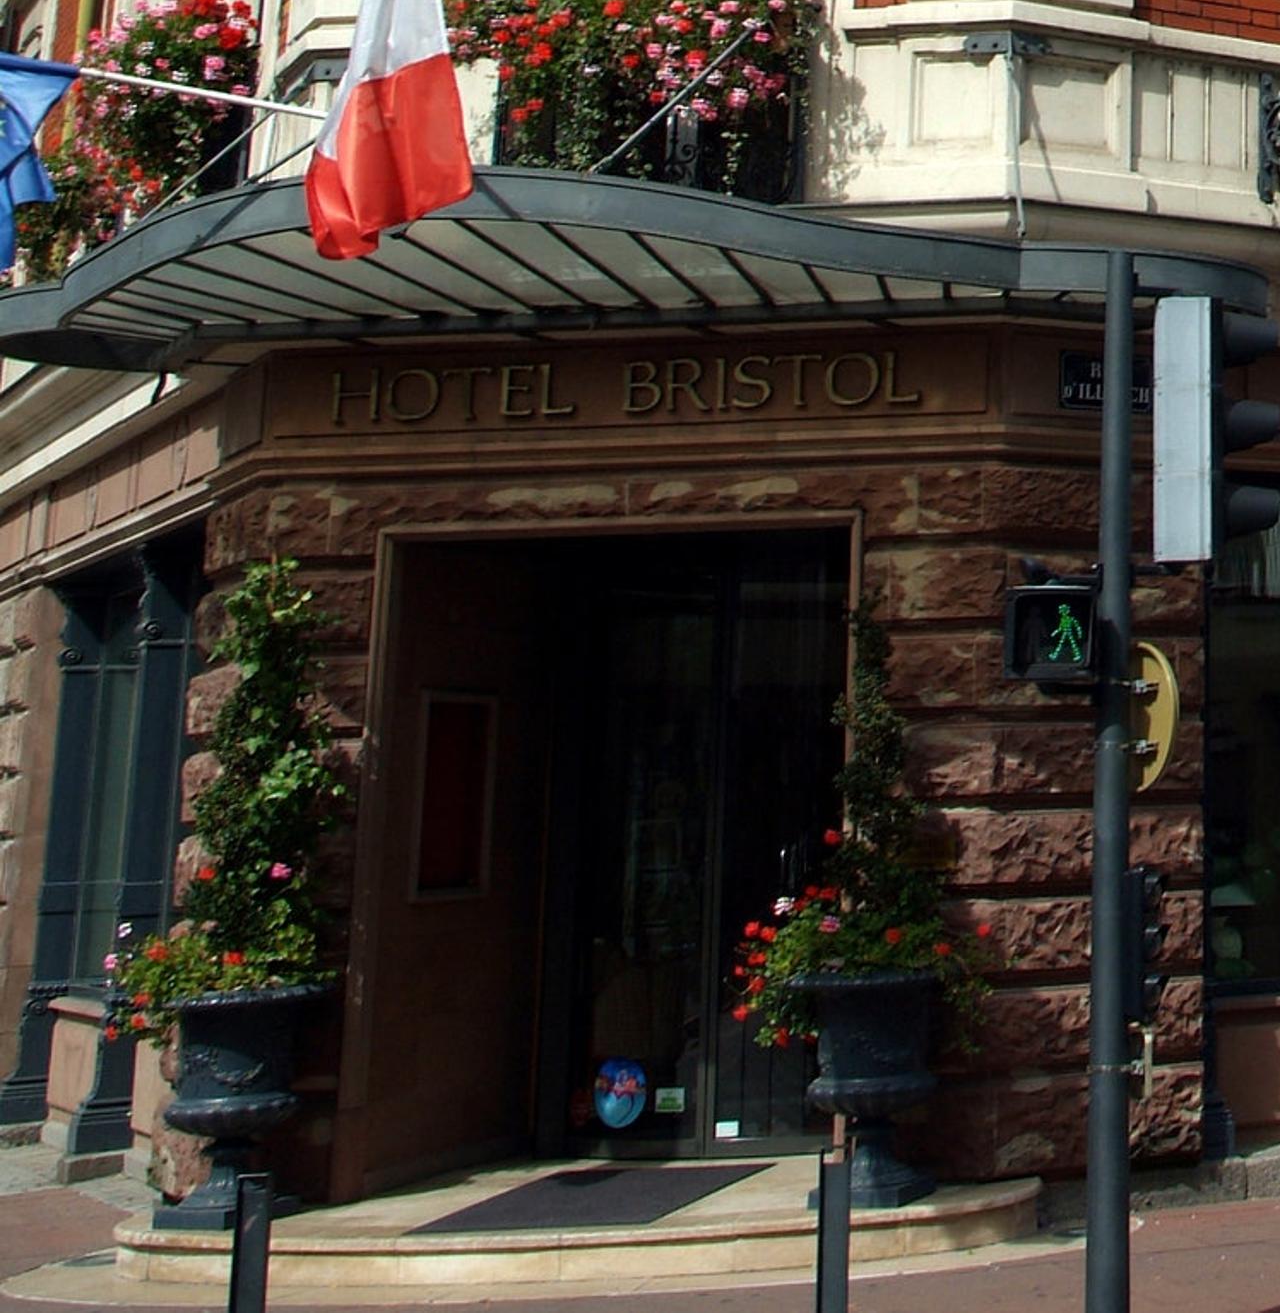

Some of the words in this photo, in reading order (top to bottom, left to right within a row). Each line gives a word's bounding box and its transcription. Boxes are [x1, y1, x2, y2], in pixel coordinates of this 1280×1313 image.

[330, 363, 576, 425] HOTEL
[621, 352, 920, 415] BRISTOL
[1061, 382, 1151, 404] D'ILLCH
